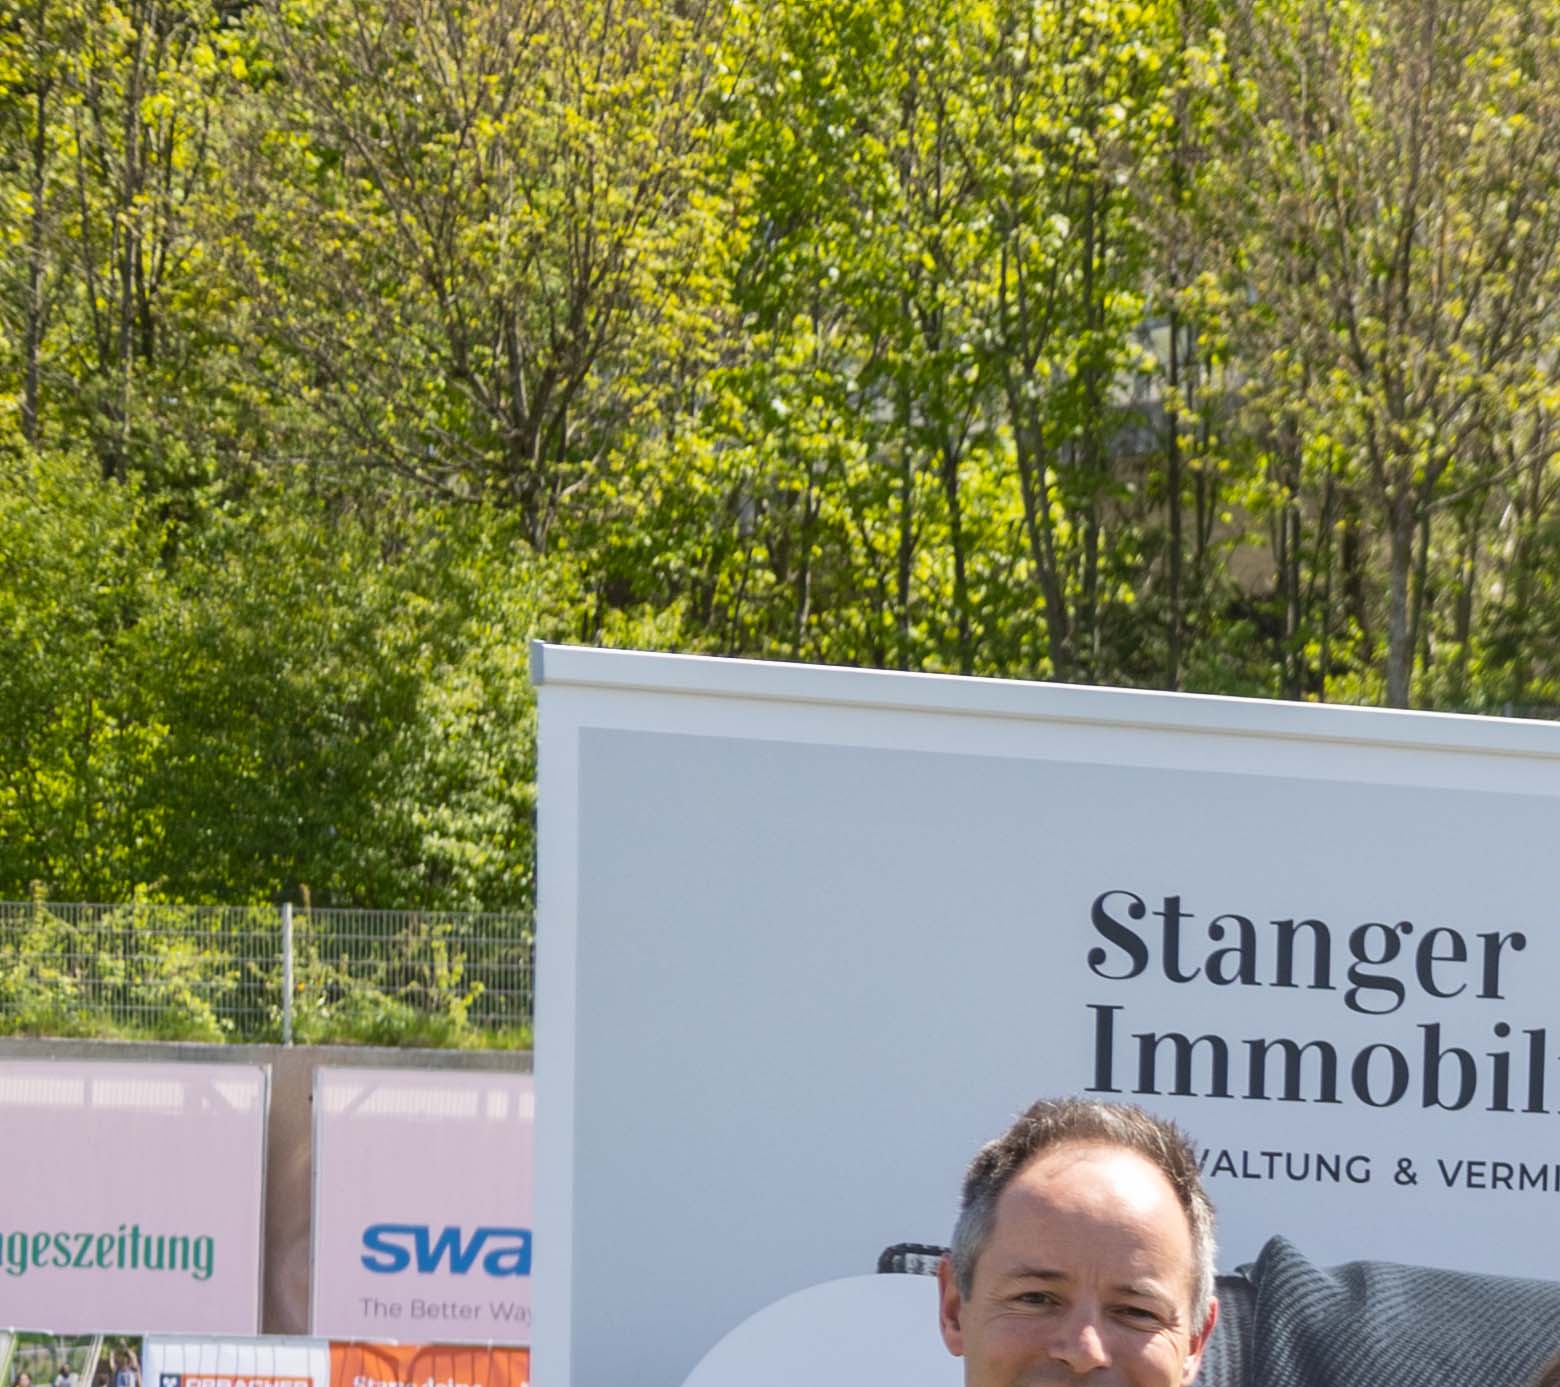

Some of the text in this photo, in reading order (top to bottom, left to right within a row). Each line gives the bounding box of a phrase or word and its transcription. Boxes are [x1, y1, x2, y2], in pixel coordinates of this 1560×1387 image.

[1086, 889, 1528, 1016] Stanger
[1199, 1149, 1372, 1187] ALTUNG
[1394, 1155, 1419, 1188] &
[0, 1224, 216, 1281] geszeitung
[360, 1223, 533, 1278] swa
[360, 1297, 403, 1320] The
[410, 1298, 482, 1321] Better
